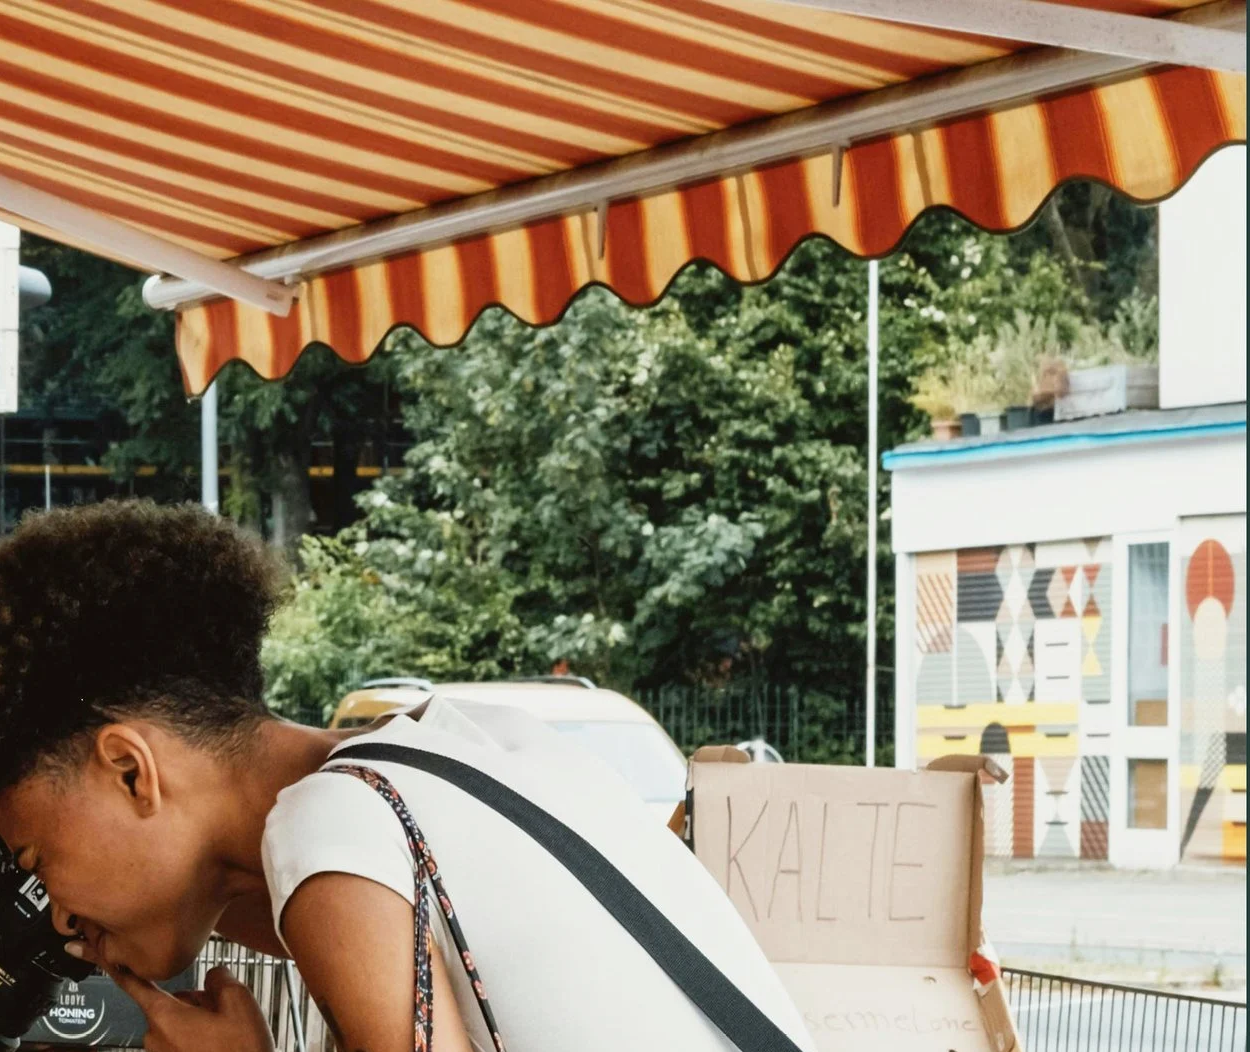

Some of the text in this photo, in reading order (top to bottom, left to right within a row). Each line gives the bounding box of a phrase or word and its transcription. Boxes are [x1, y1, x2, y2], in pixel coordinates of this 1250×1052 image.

[726, 795, 937, 922] KALTE
[60, 994, 86, 1007] LOOYE
[49, 1007, 96, 1019] HONING
